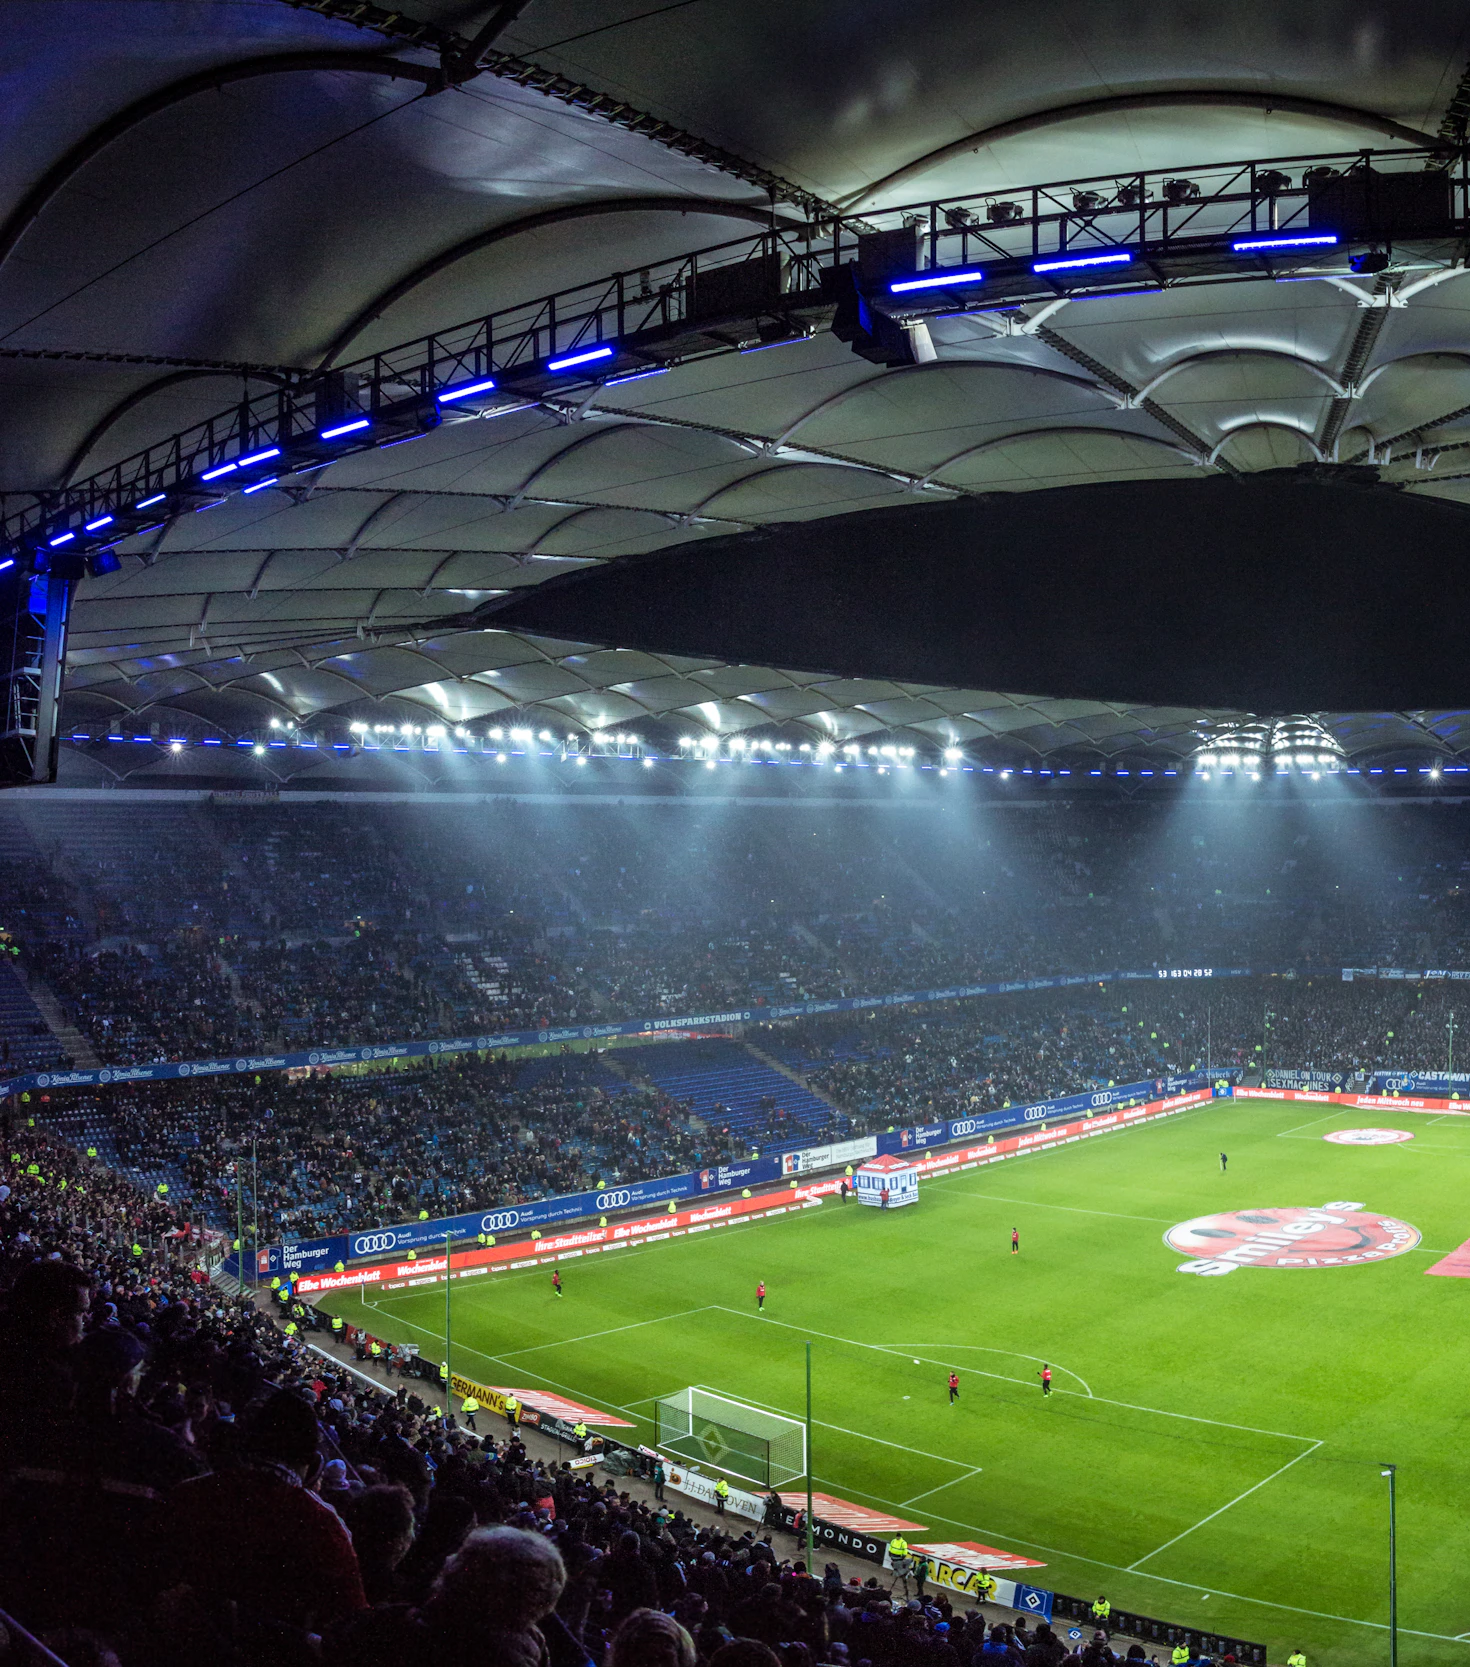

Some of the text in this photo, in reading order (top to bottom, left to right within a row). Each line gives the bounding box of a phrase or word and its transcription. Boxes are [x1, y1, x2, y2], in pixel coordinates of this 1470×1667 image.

[654, 1012, 742, 1029] VOLKSPARKSTADION
[1275, 1069, 1331, 1082] DANIEL ON TOUR
[1236, 1089, 1285, 1099] Elbe Wochenblatt
[1294, 1093, 1329, 1102] Wochenblatt
[1377, 1096, 1410, 1106] Mittwoch
[1448, 1102, 1462, 1110] Elbe
[916, 1128, 942, 1139] Hamburger
[916, 1137, 927, 1145] Weg
[801, 1153, 830, 1164] Hamburger
[967, 1146, 997, 1159] Wochenblatt
[927, 1155, 959, 1170] Wochenblatt
[718, 1166, 729, 1174] Der
[718, 1168, 751, 1180] Hamburger
[718, 1178, 732, 1186] Weg
[631, 1192, 657, 1201] Vorsprung
[670, 1186, 688, 1194] Technik
[794, 1189, 809, 1199] Ihre
[520, 1213, 548, 1223] Vorsprung
[563, 1206, 583, 1214] Technik
[690, 1207, 732, 1223] Wochenblatt
[614, 1218, 678, 1238] Elbe Wochenblatt
[397, 1235, 427, 1246] Vorsprung
[1176, 1200, 1366, 1277] Smiley's
[1276, 1220, 1412, 1266] Pizza Profis
[283, 1244, 299, 1254] Der
[535, 1240, 553, 1252] Ihre
[283, 1247, 330, 1261] Hamburger
[283, 1260, 302, 1269] Weg
[299, 1270, 381, 1292] Elbe Wochenblatt
[388, 1281, 406, 1290] tipico
[683, 1480, 757, 1514] J.J.DAROVEN
